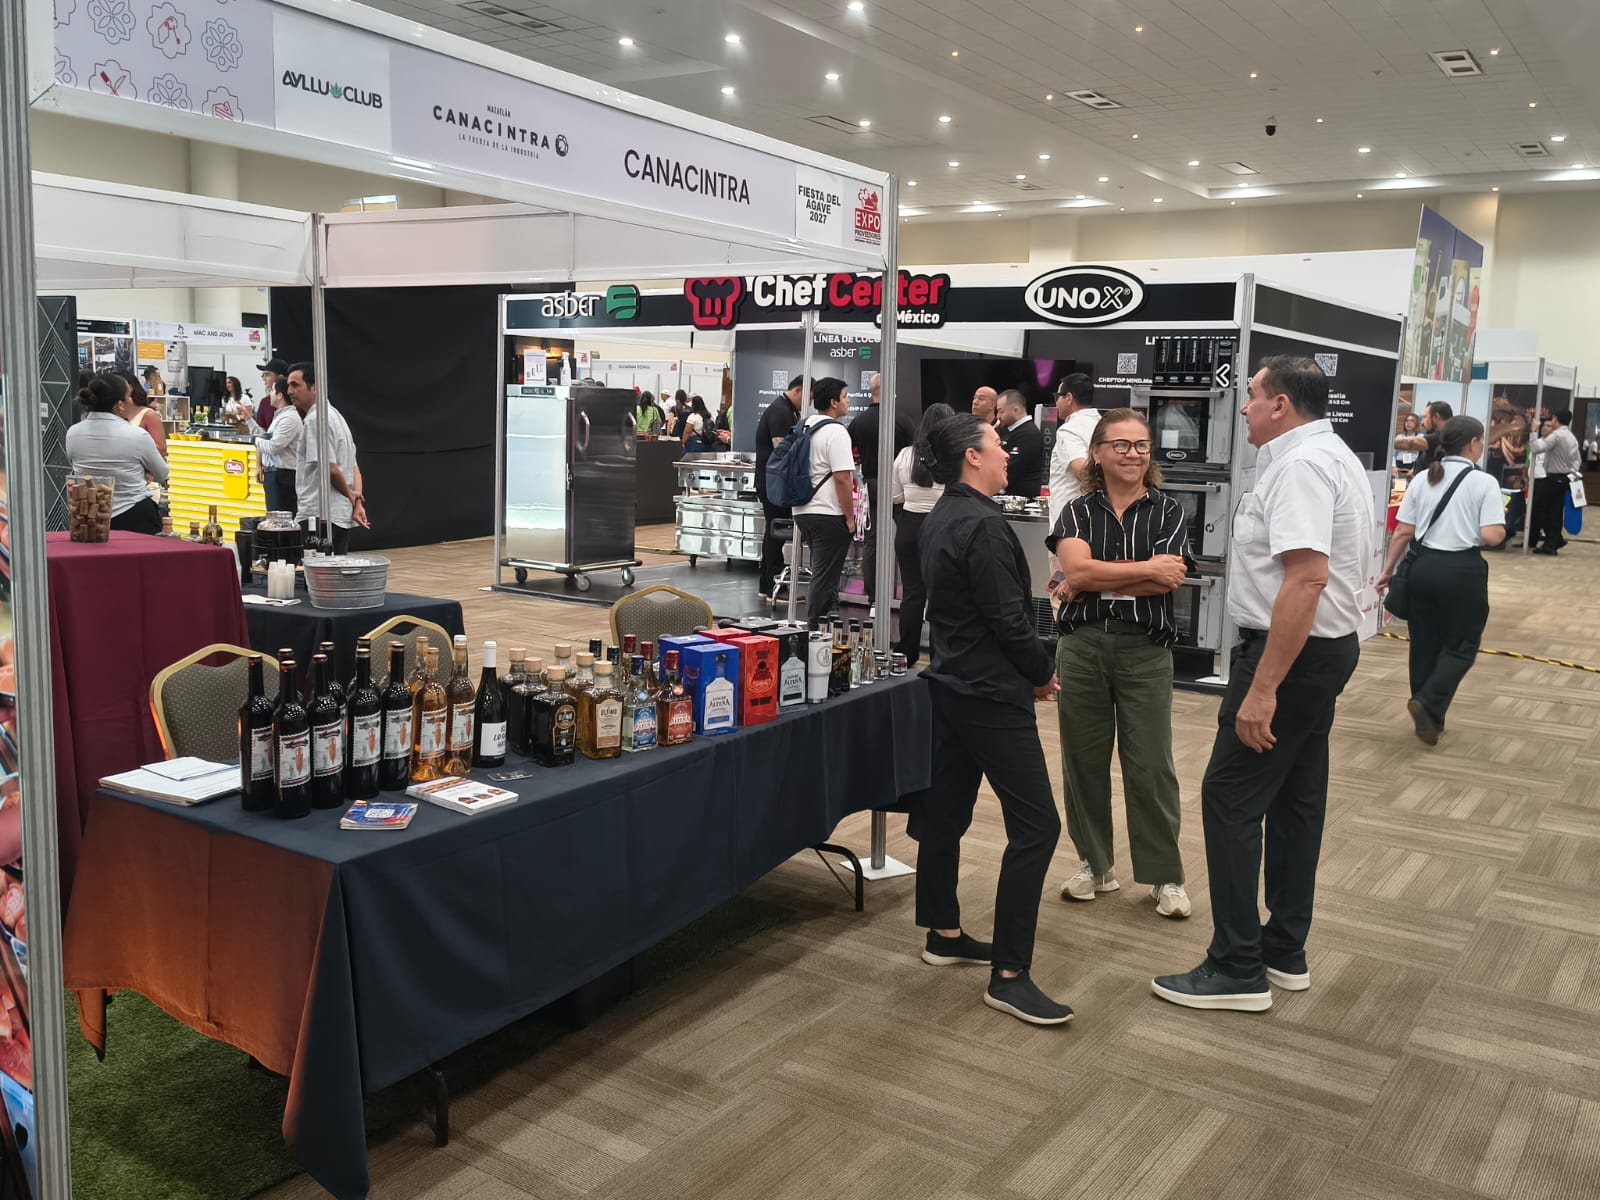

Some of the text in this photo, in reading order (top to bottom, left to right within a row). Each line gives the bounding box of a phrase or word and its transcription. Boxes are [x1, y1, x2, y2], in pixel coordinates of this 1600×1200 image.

[282, 70, 383, 109] AYLLU CLUB
[433, 105, 550, 149] CANACINTRA
[624, 149, 750, 205] CANACINTRA
[798, 185, 842, 207] FIESTA DEL
[806, 198, 832, 215] AGAVE
[809, 211, 828, 225] 2027
[855, 210, 881, 230] EXPO
[754, 273, 828, 307] Chef
[541, 290, 600, 317] asber
[813, 332, 841, 344] LÍNEA
[830, 346, 857, 358] asber
